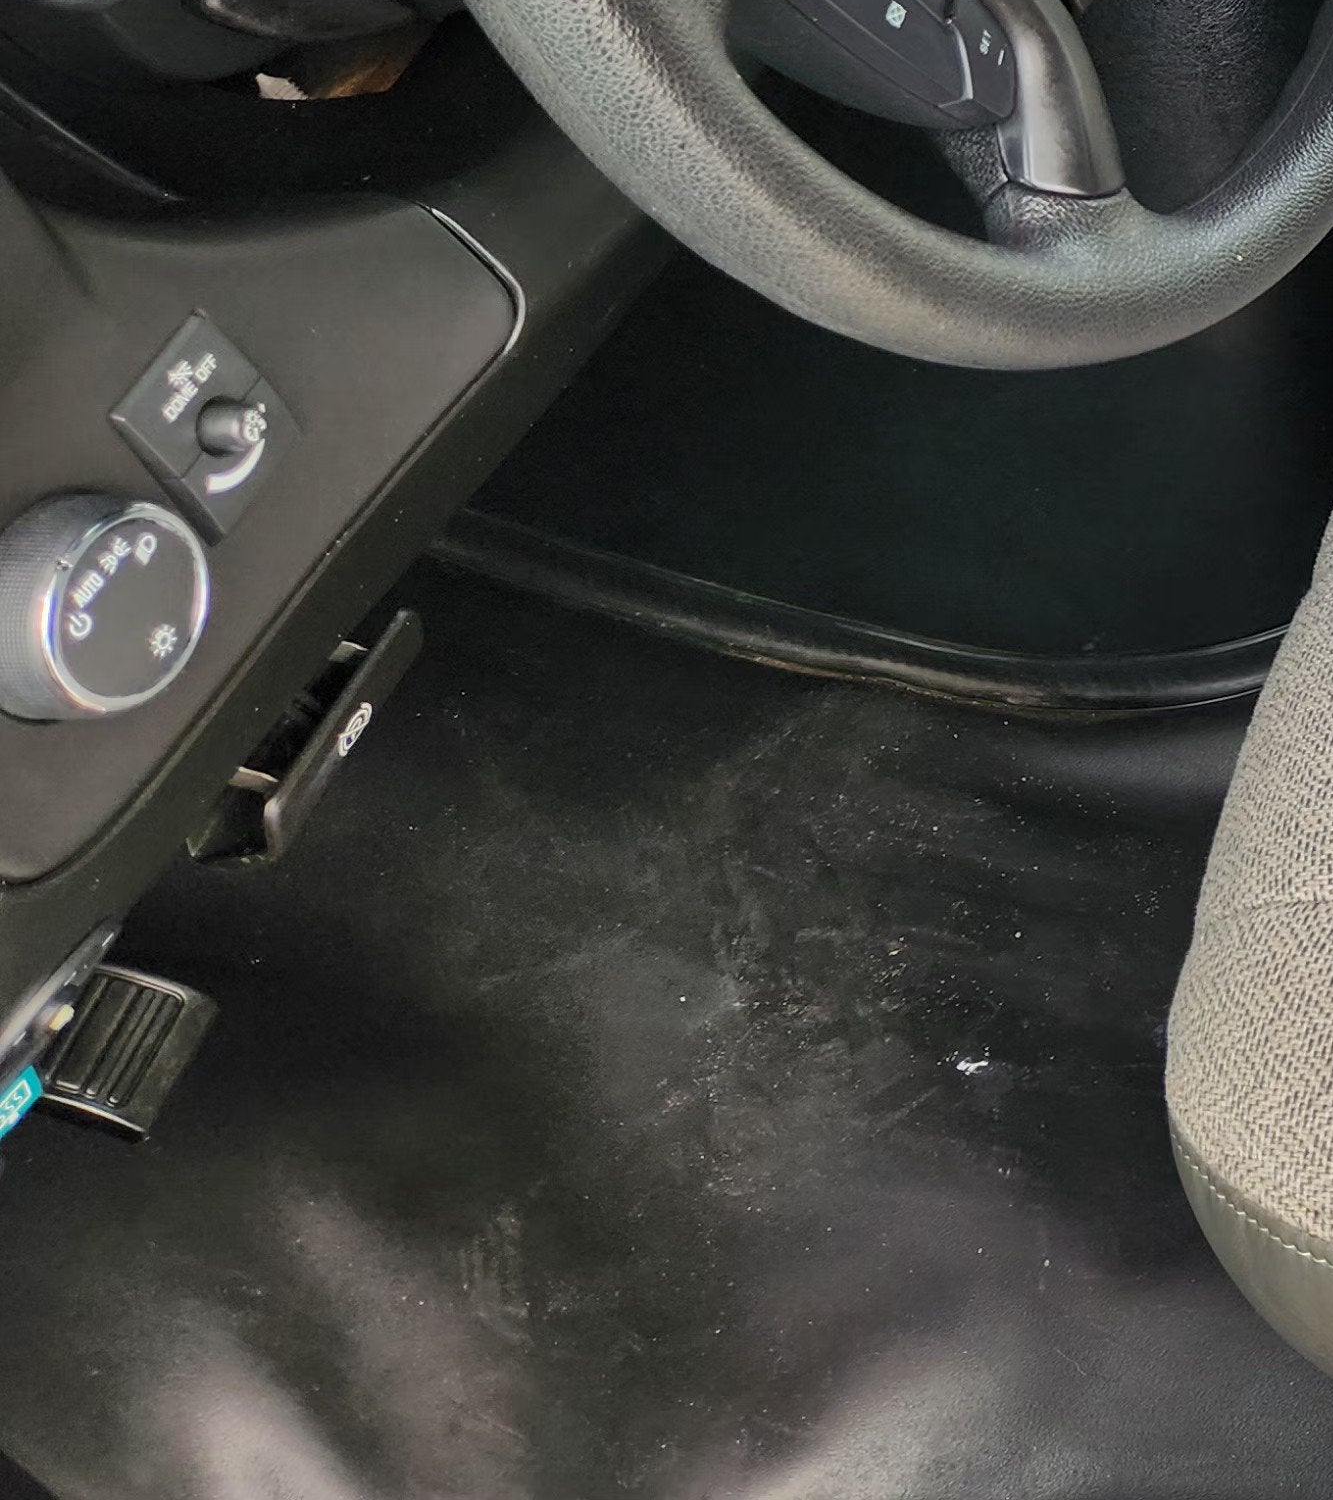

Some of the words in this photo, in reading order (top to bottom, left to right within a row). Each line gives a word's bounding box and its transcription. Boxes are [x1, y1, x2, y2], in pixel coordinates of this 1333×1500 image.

[161, 380, 199, 424] DOME
[194, 352, 218, 384] OFF
[71, 569, 105, 609] AUTO
